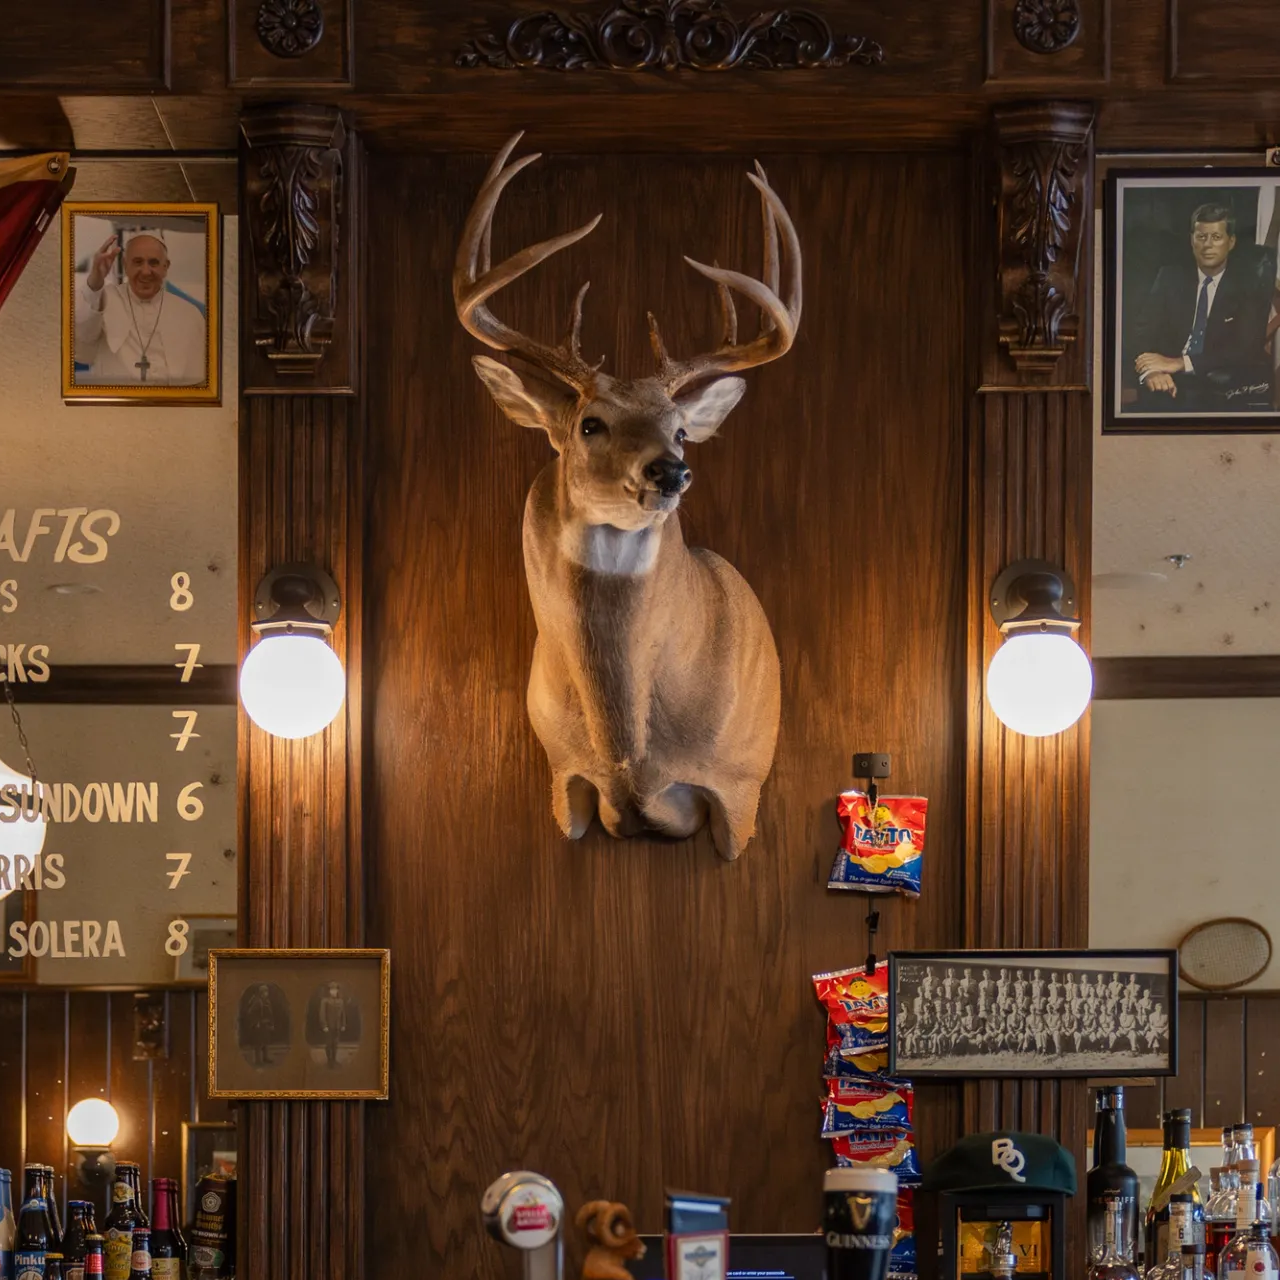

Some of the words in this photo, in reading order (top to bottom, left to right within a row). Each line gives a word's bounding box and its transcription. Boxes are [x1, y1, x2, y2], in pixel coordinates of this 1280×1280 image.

[170, 572, 194, 611] 8
[174, 643, 204, 683] 7
[170, 711, 200, 752] 7
[0, 782, 158, 823] SUNDOWN
[177, 782, 204, 822] 6
[166, 853, 192, 890] 7
[8, 920, 126, 959] SOLERA
[164, 920, 190, 957] 8
[826, 1231, 891, 1249] GUINNESS
[1019, 1245, 1038, 1257] VI
[1179, 1228, 1184, 1239] 6
